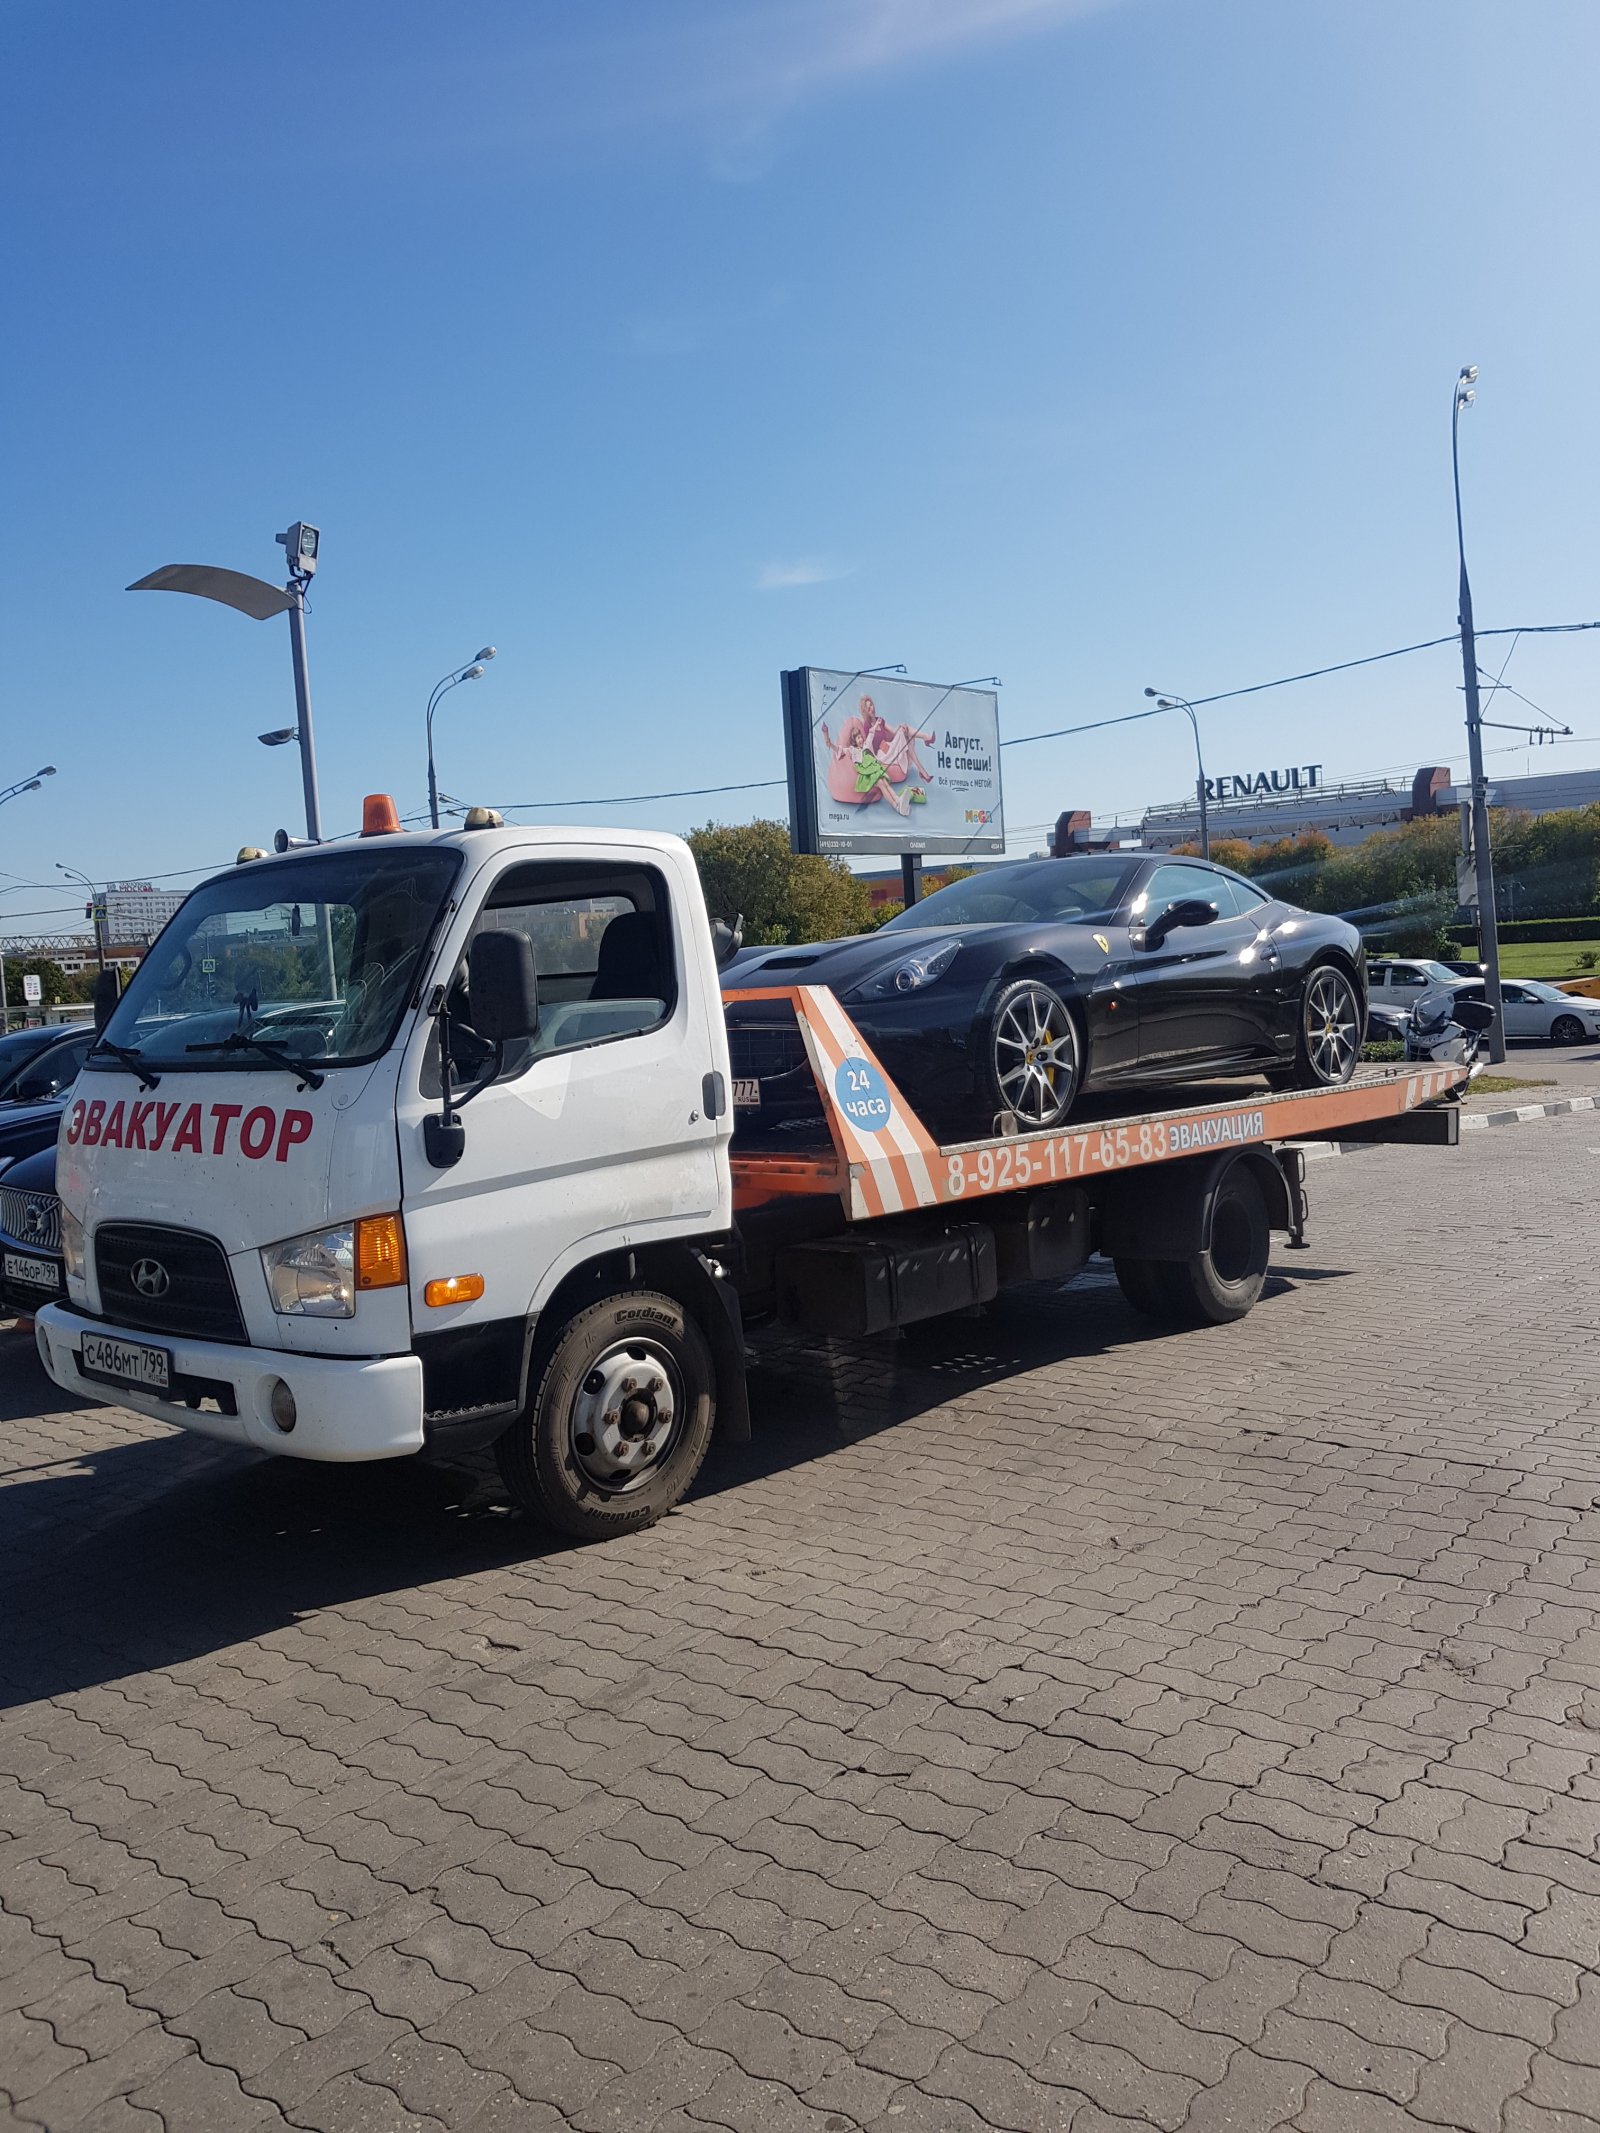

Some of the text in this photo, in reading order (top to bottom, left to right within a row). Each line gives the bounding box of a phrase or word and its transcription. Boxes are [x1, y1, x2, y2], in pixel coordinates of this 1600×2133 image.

[945, 731, 984, 754] Август.
[937, 751, 992, 772] Не спеши!
[1196, 764, 1322, 800] RENAULT
[829, 813, 850, 822] mega.ru
[732, 1081, 754, 1096] 777
[847, 1069, 871, 1091] 24
[846, 1098, 887, 1117] часа
[67, 1099, 313, 1162] ЭВАКУАТОР
[948, 1111, 1265, 1196] 8-925-117-65-83 ЭВАКУАЦИЯ
[616, 1307, 678, 1327] Cordiant
